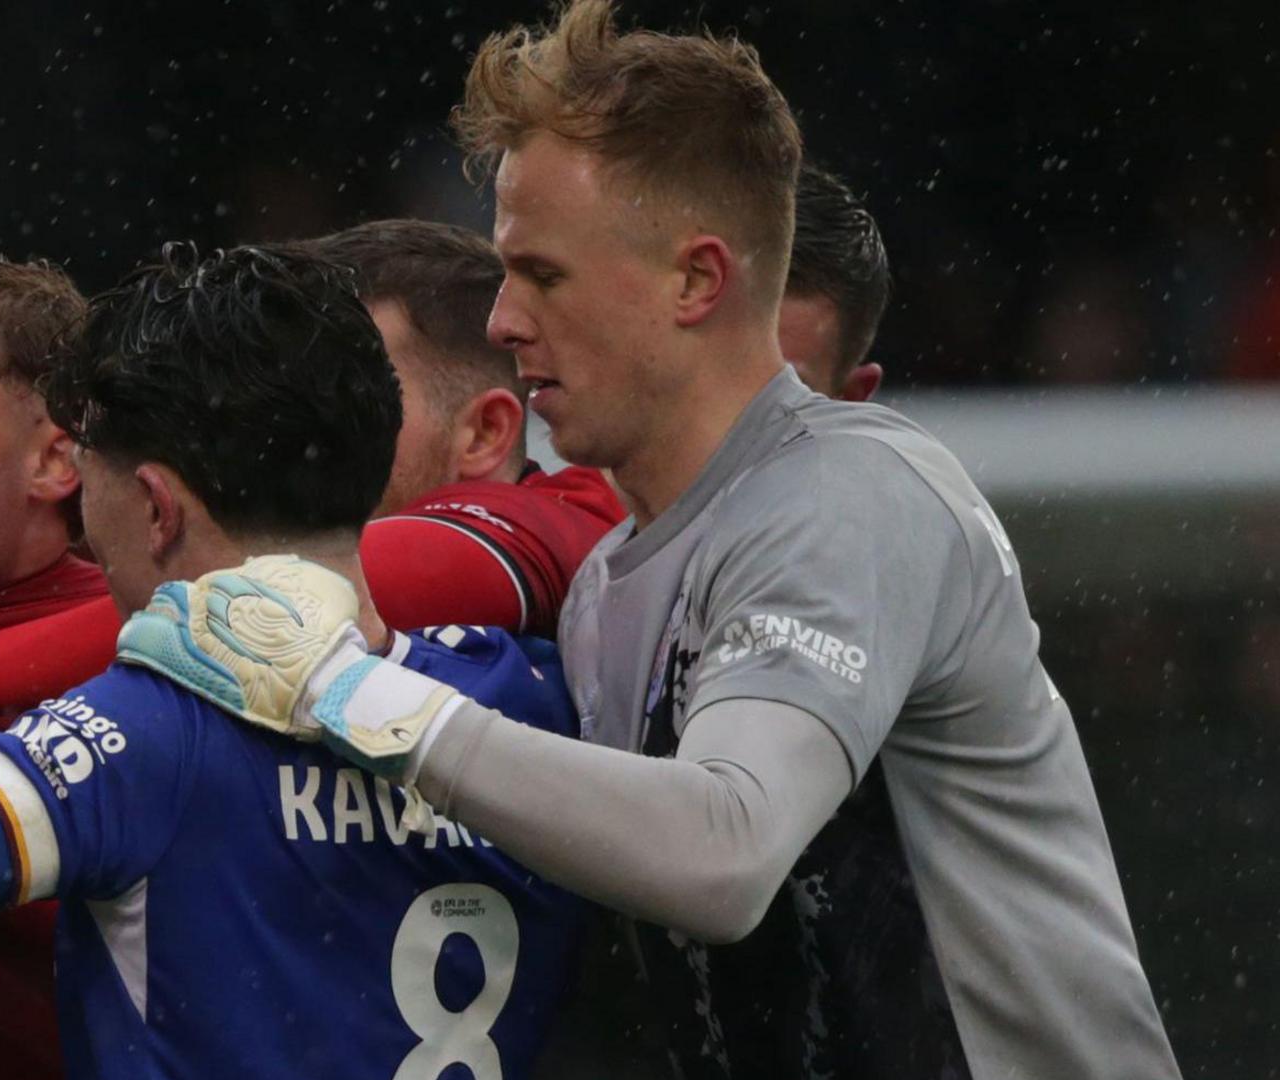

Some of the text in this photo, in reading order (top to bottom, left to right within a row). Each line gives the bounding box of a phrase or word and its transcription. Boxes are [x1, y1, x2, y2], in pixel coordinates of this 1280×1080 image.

[750, 614, 867, 670] ENVIRO
[755, 635, 861, 684] SKIP HIRE LTD
